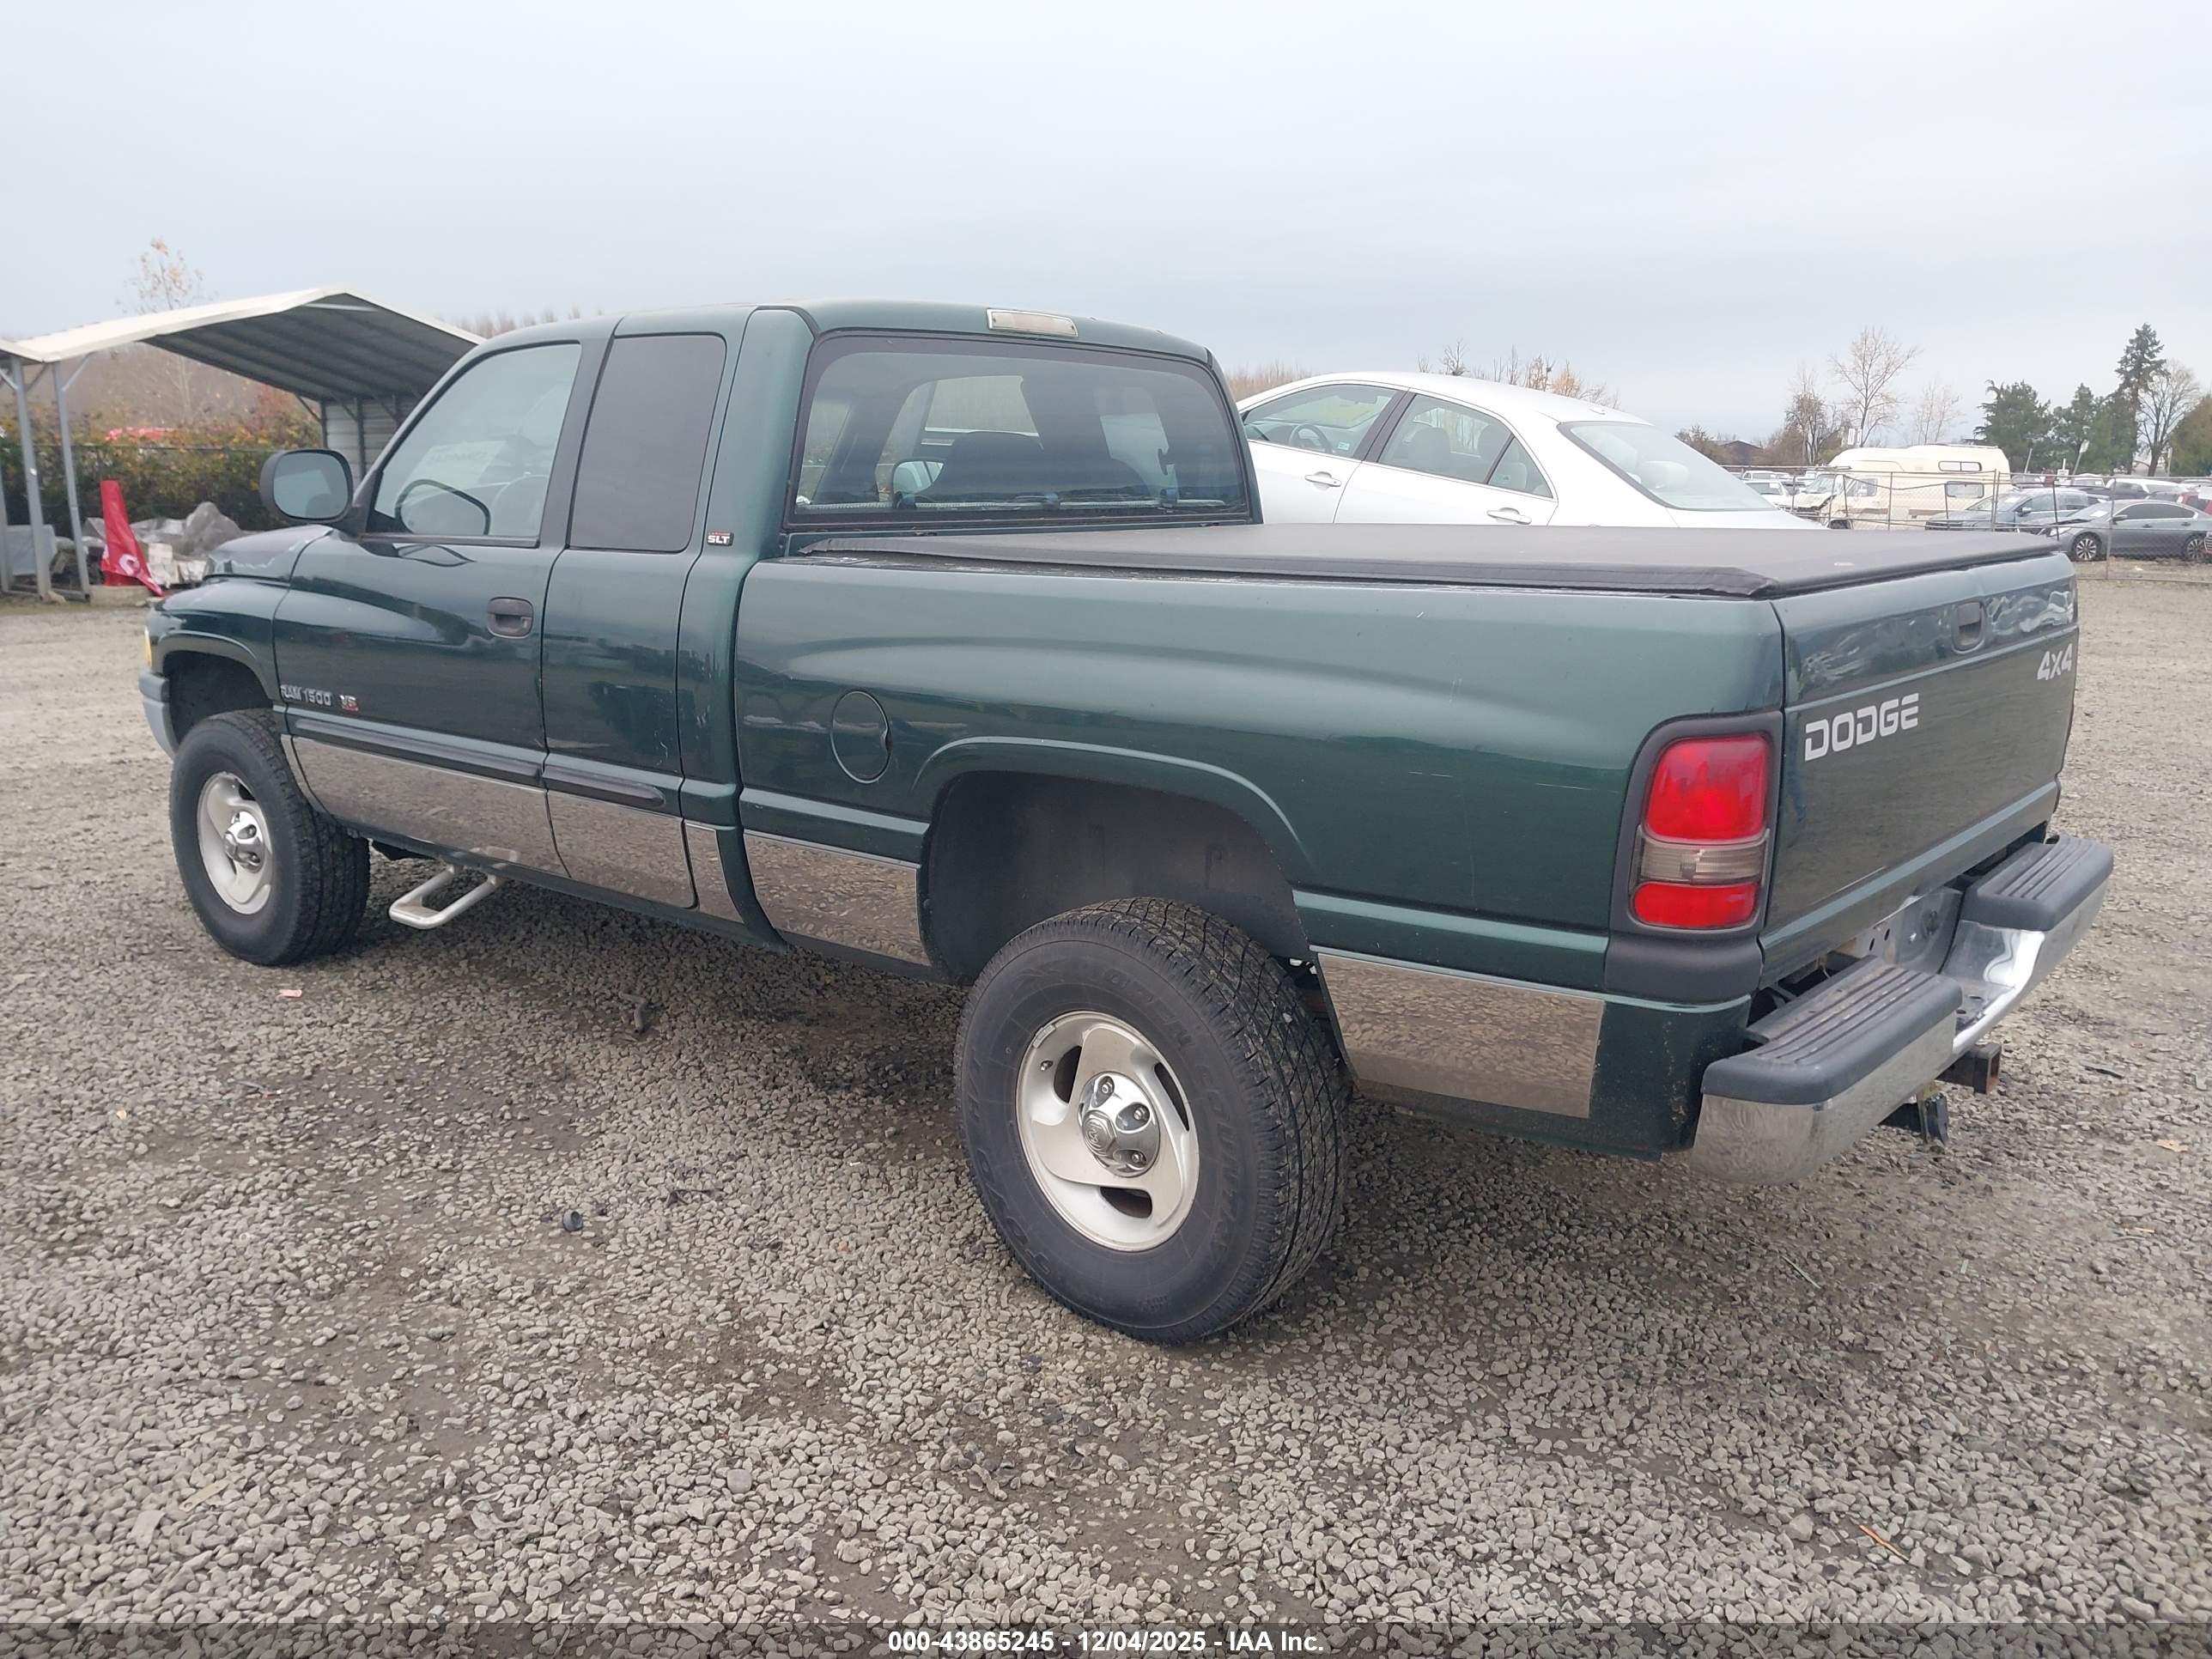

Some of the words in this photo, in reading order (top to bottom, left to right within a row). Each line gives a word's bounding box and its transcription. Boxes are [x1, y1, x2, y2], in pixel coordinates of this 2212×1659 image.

[708, 535, 730, 544] SLT
[280, 684, 302, 701] RAM
[302, 688, 332, 706] 1500
[1805, 693, 1919, 762] DODGE
